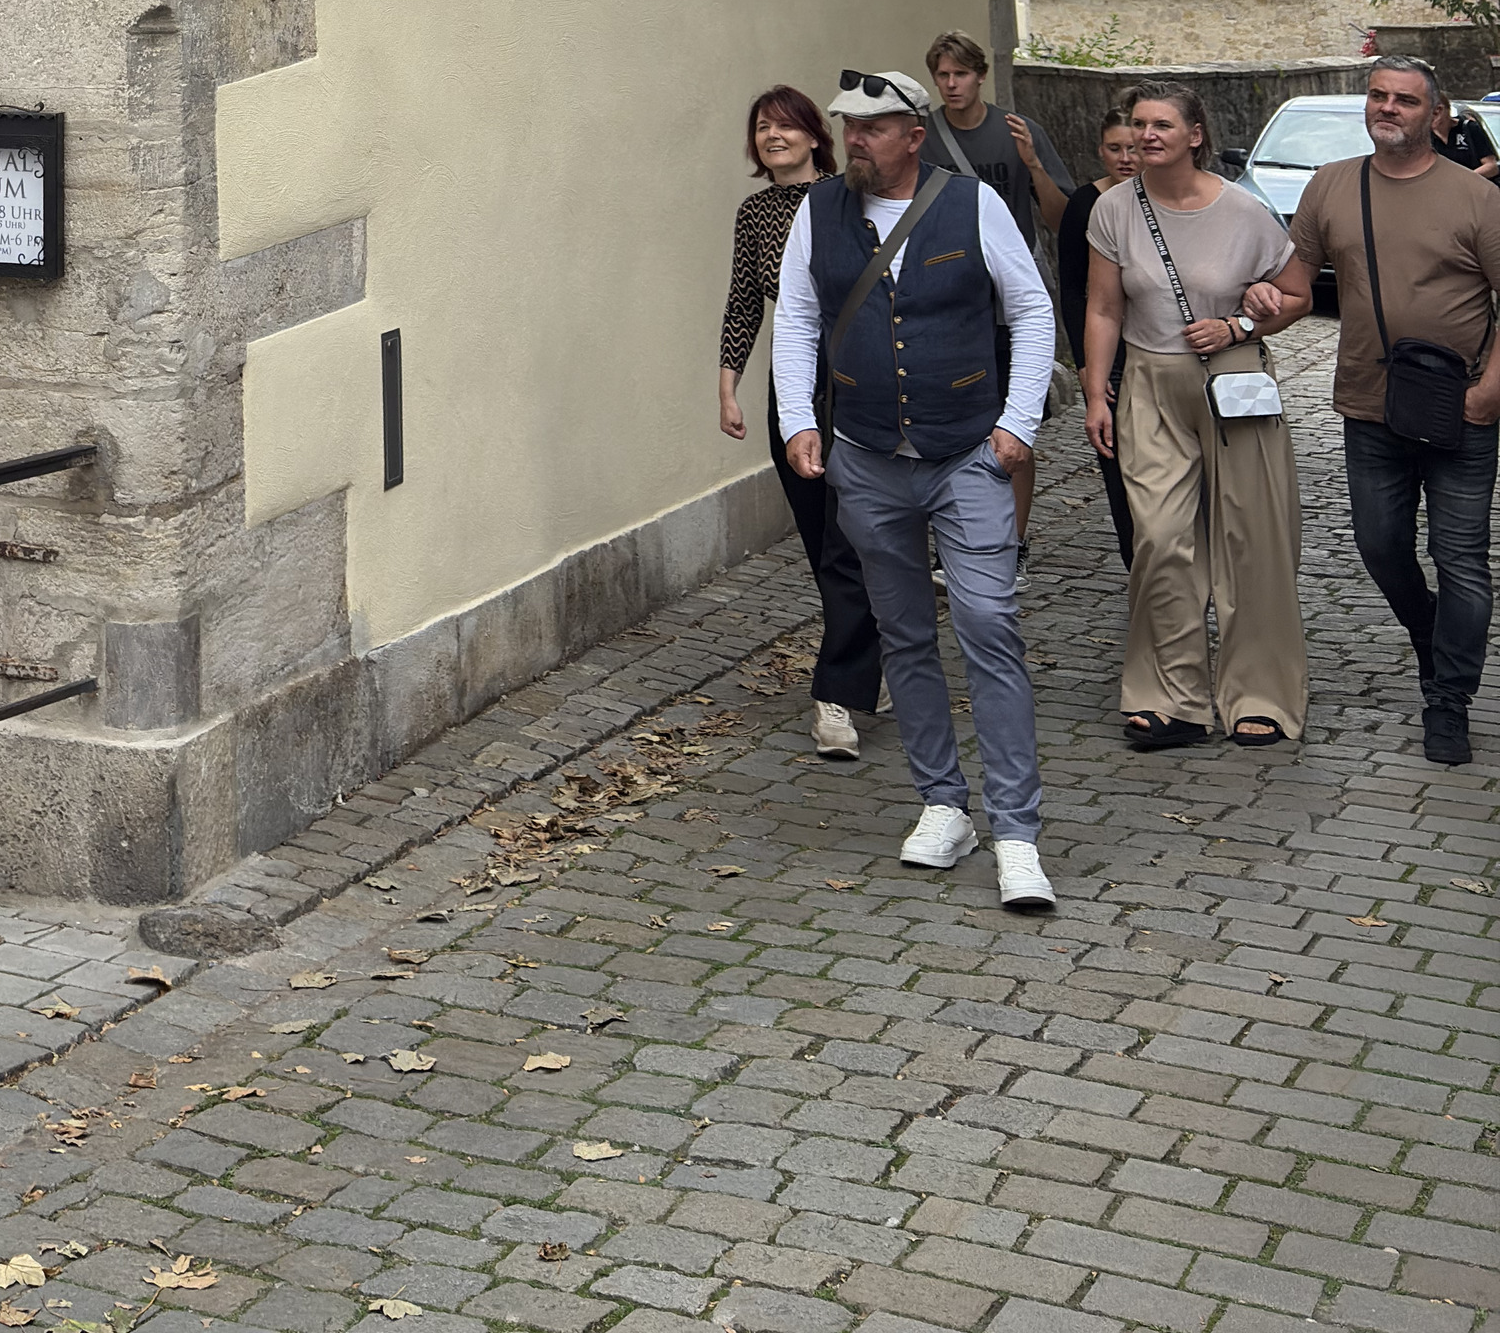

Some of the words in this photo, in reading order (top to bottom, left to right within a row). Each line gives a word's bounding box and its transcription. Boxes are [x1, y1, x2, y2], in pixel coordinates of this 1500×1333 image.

[1140, 198, 1157, 230] FOREVER
[1153, 231, 1168, 256] YOUNG
[1165, 261, 1182, 294] FOREVER
[1178, 296, 1193, 322] YOUNG
